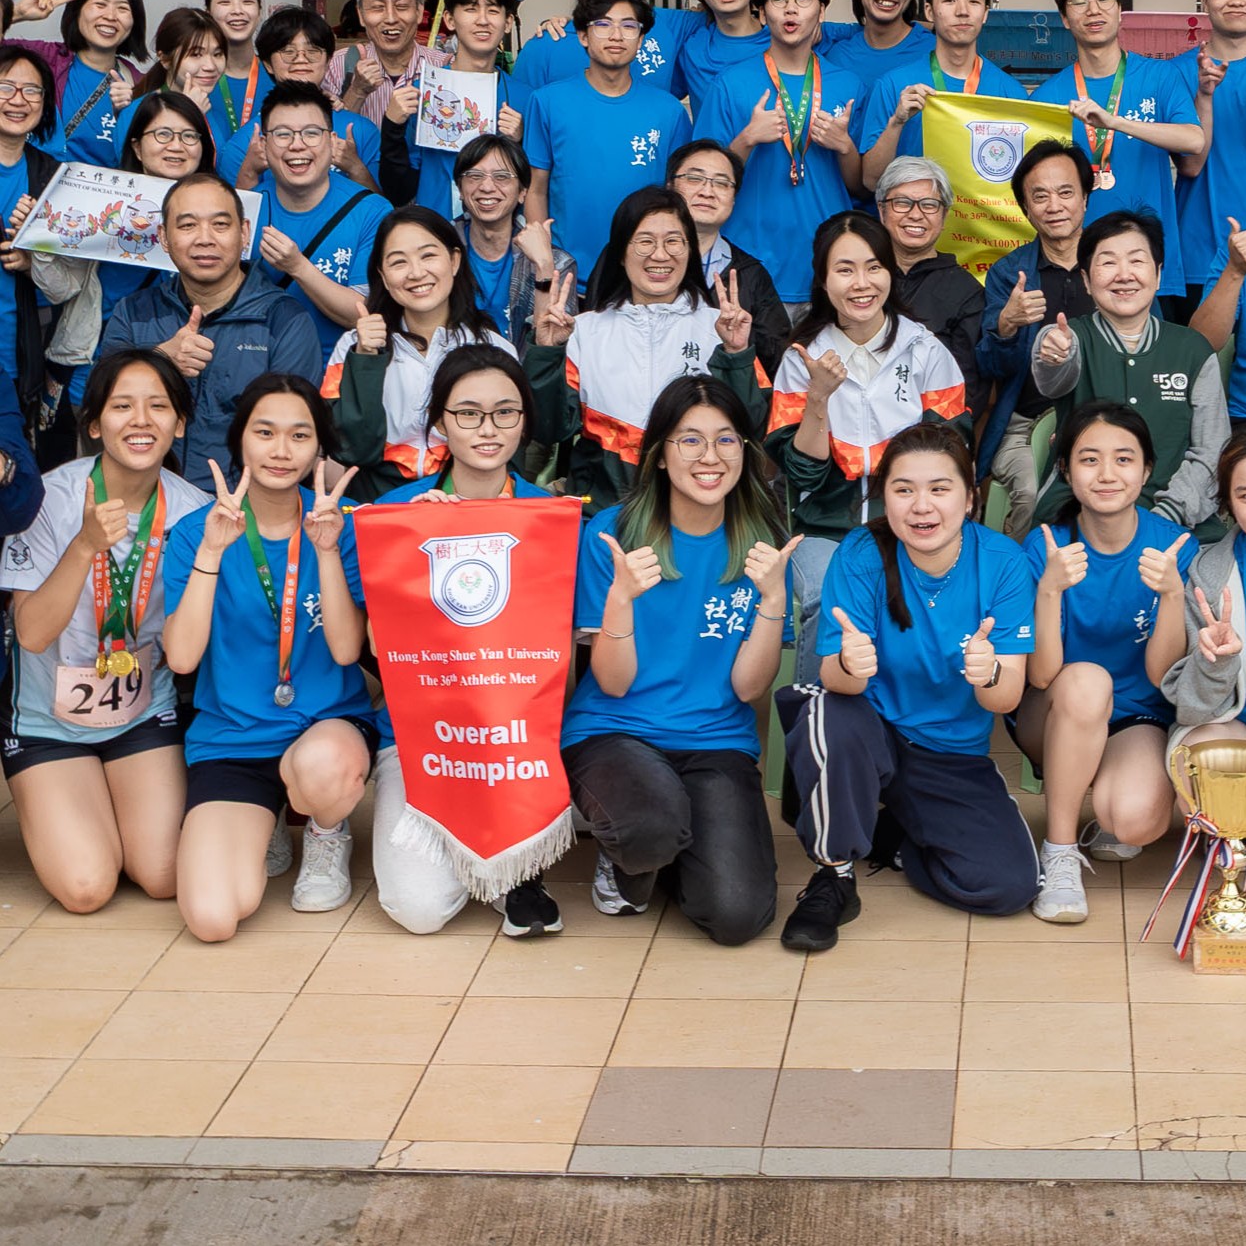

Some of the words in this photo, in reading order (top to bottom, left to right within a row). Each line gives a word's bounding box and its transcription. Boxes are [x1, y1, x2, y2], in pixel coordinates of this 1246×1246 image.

[974, 123, 1022, 138] 樹仁大學
[630, 135, 647, 166] 社工
[956, 194, 979, 207] Kong
[980, 194, 1002, 207] Shue
[953, 209, 969, 220] The
[970, 210, 988, 221] 36th
[989, 213, 1023, 224] Athletic
[952, 232, 980, 245] Men's
[982, 237, 1020, 249] 4x100M
[333, 247, 352, 283] 樹仁
[435, 538, 505, 561] 樹仁大學
[700, 596, 728, 640] 社工
[726, 588, 753, 635] 樹仁
[387, 650, 420, 664] Hong
[421, 650, 449, 664] Kong
[449, 649, 476, 662] Shue
[478, 647, 504, 660] Yan
[507, 647, 561, 663] University
[68, 666, 143, 714] 249
[418, 674, 439, 686] The
[440, 673, 458, 687] 36th
[459, 672, 506, 686] Athletic
[509, 672, 537, 685] Meet
[434, 719, 529, 745] Overall
[422, 753, 550, 787] Champion
